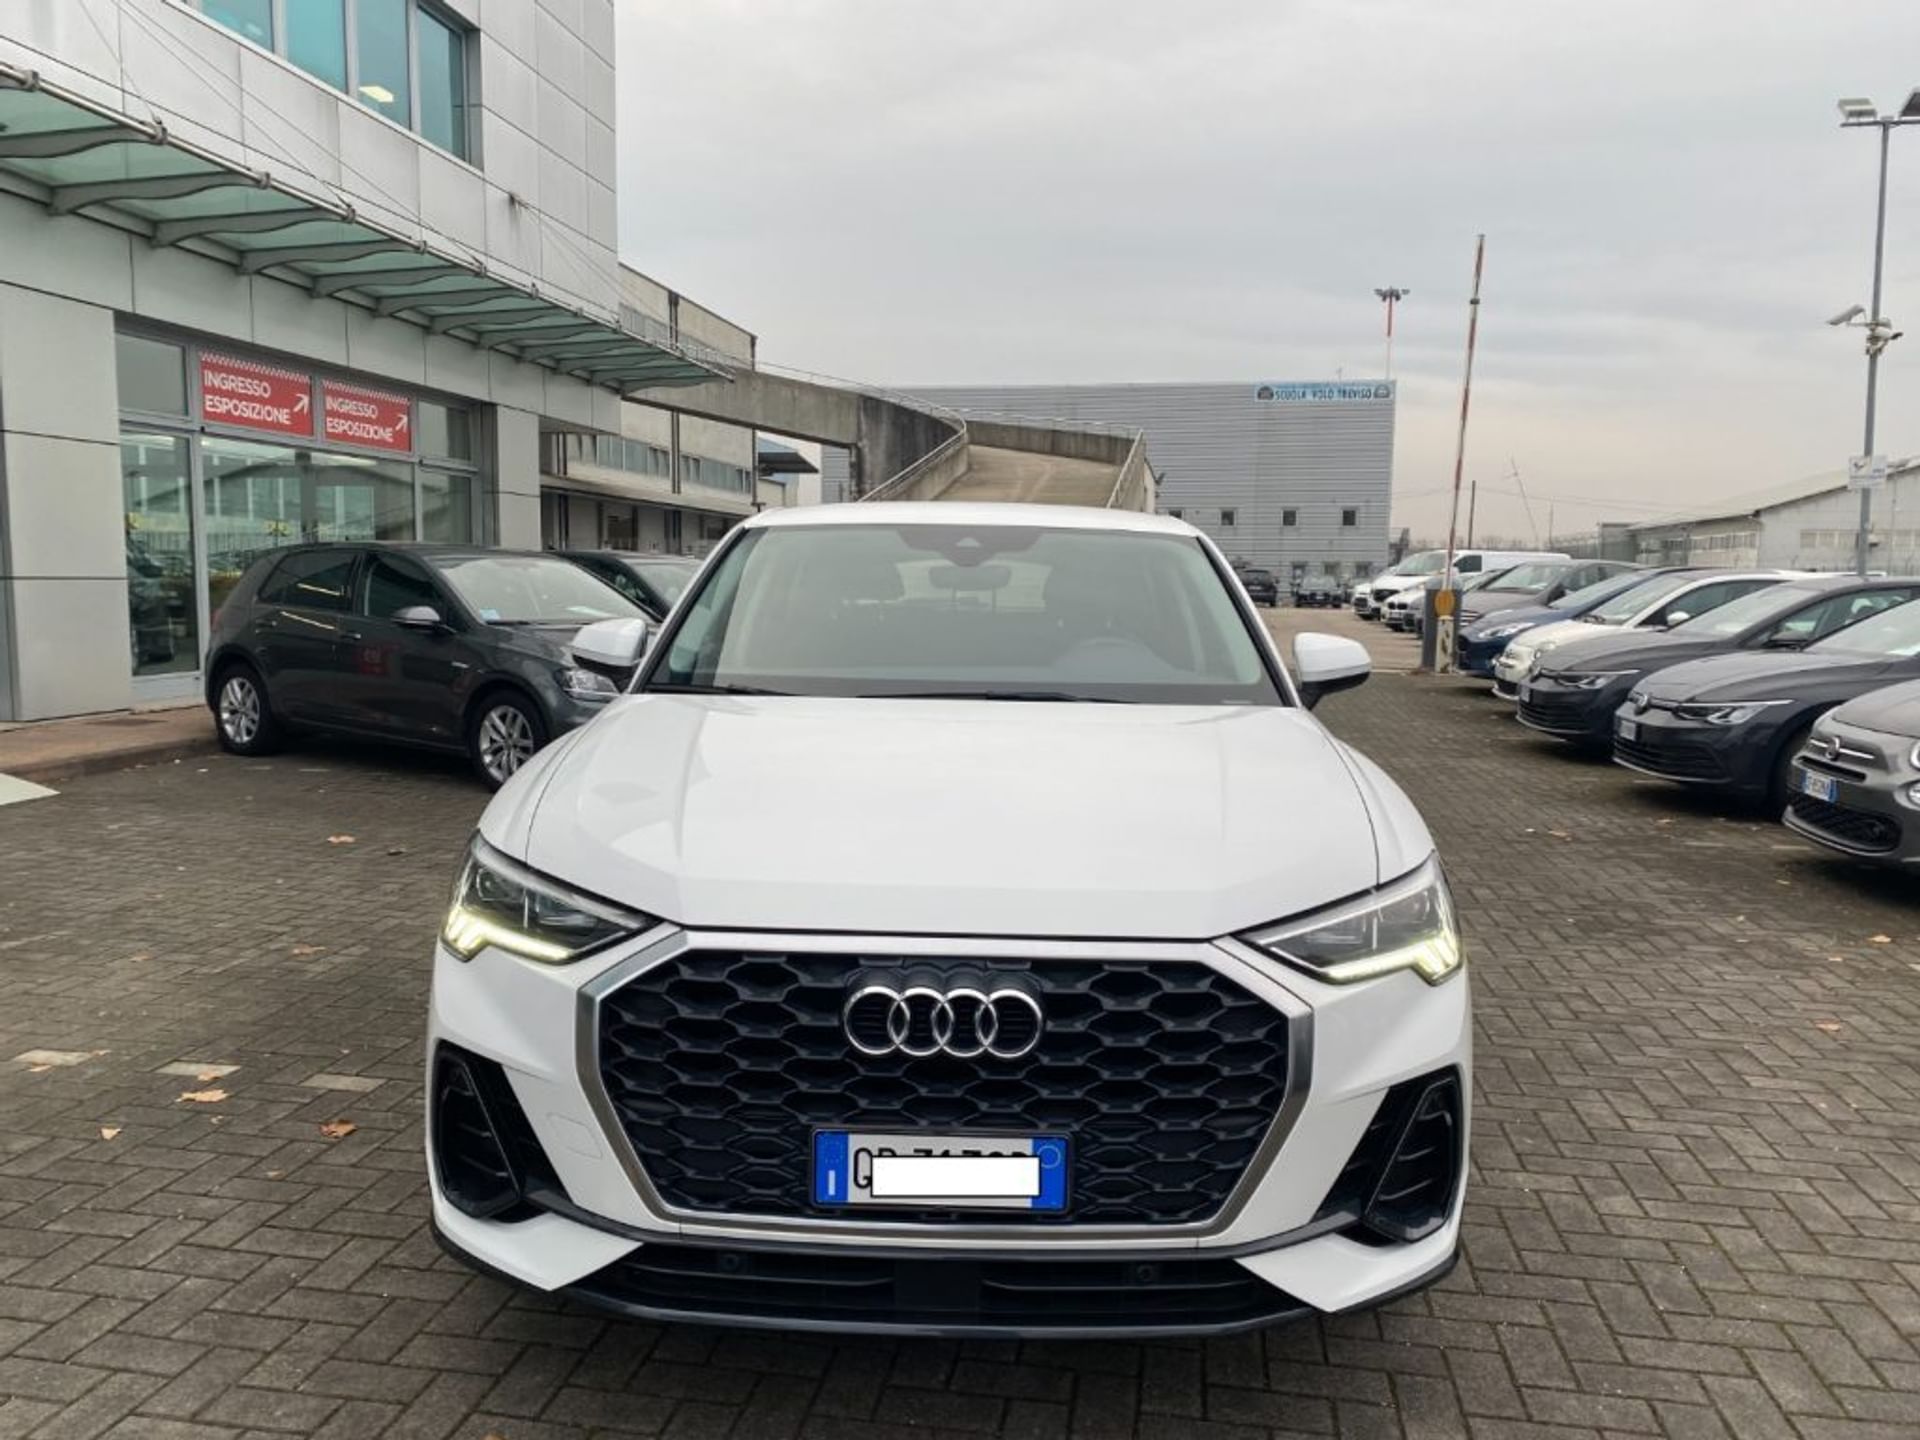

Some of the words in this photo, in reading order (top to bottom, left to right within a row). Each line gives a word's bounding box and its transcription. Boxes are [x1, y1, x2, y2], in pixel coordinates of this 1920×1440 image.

[204, 371, 271, 398] INGRESSO
[205, 395, 291, 424] ESPOSIZIONE
[326, 395, 378, 419] INGRESSO
[326, 417, 393, 443] ESPOSIZIONE
